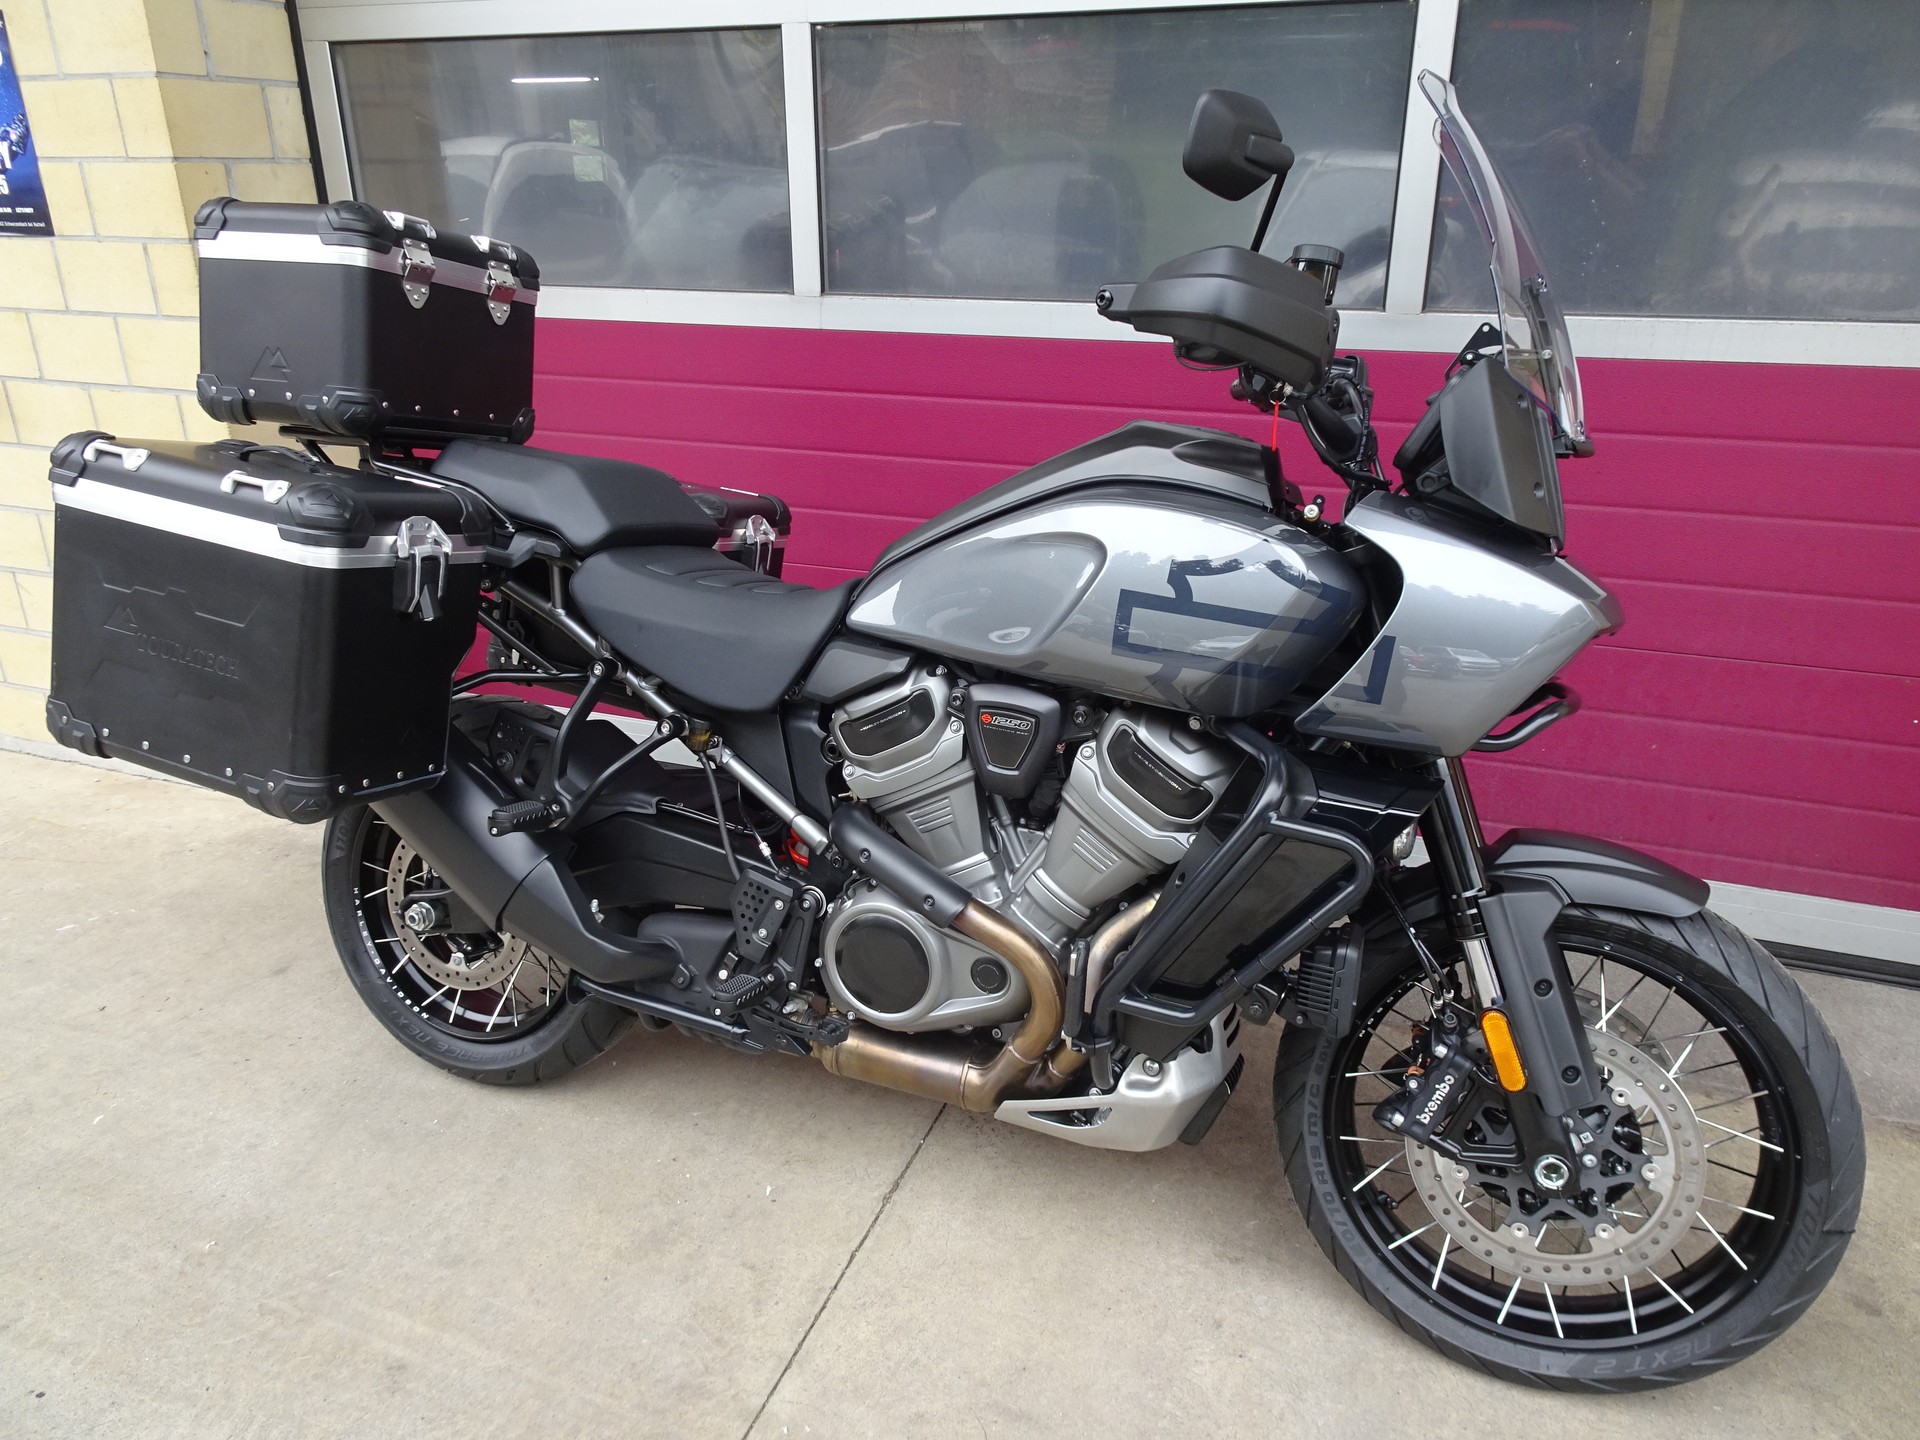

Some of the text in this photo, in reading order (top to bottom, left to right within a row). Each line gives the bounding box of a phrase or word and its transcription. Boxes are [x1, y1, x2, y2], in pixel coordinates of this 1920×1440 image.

[137, 632, 240, 679] TOURATECH
[991, 715, 1032, 730] 1250
[353, 887, 429, 1019] HARLEY-DAVIDSON
[1415, 1074, 1455, 1125] brembo
